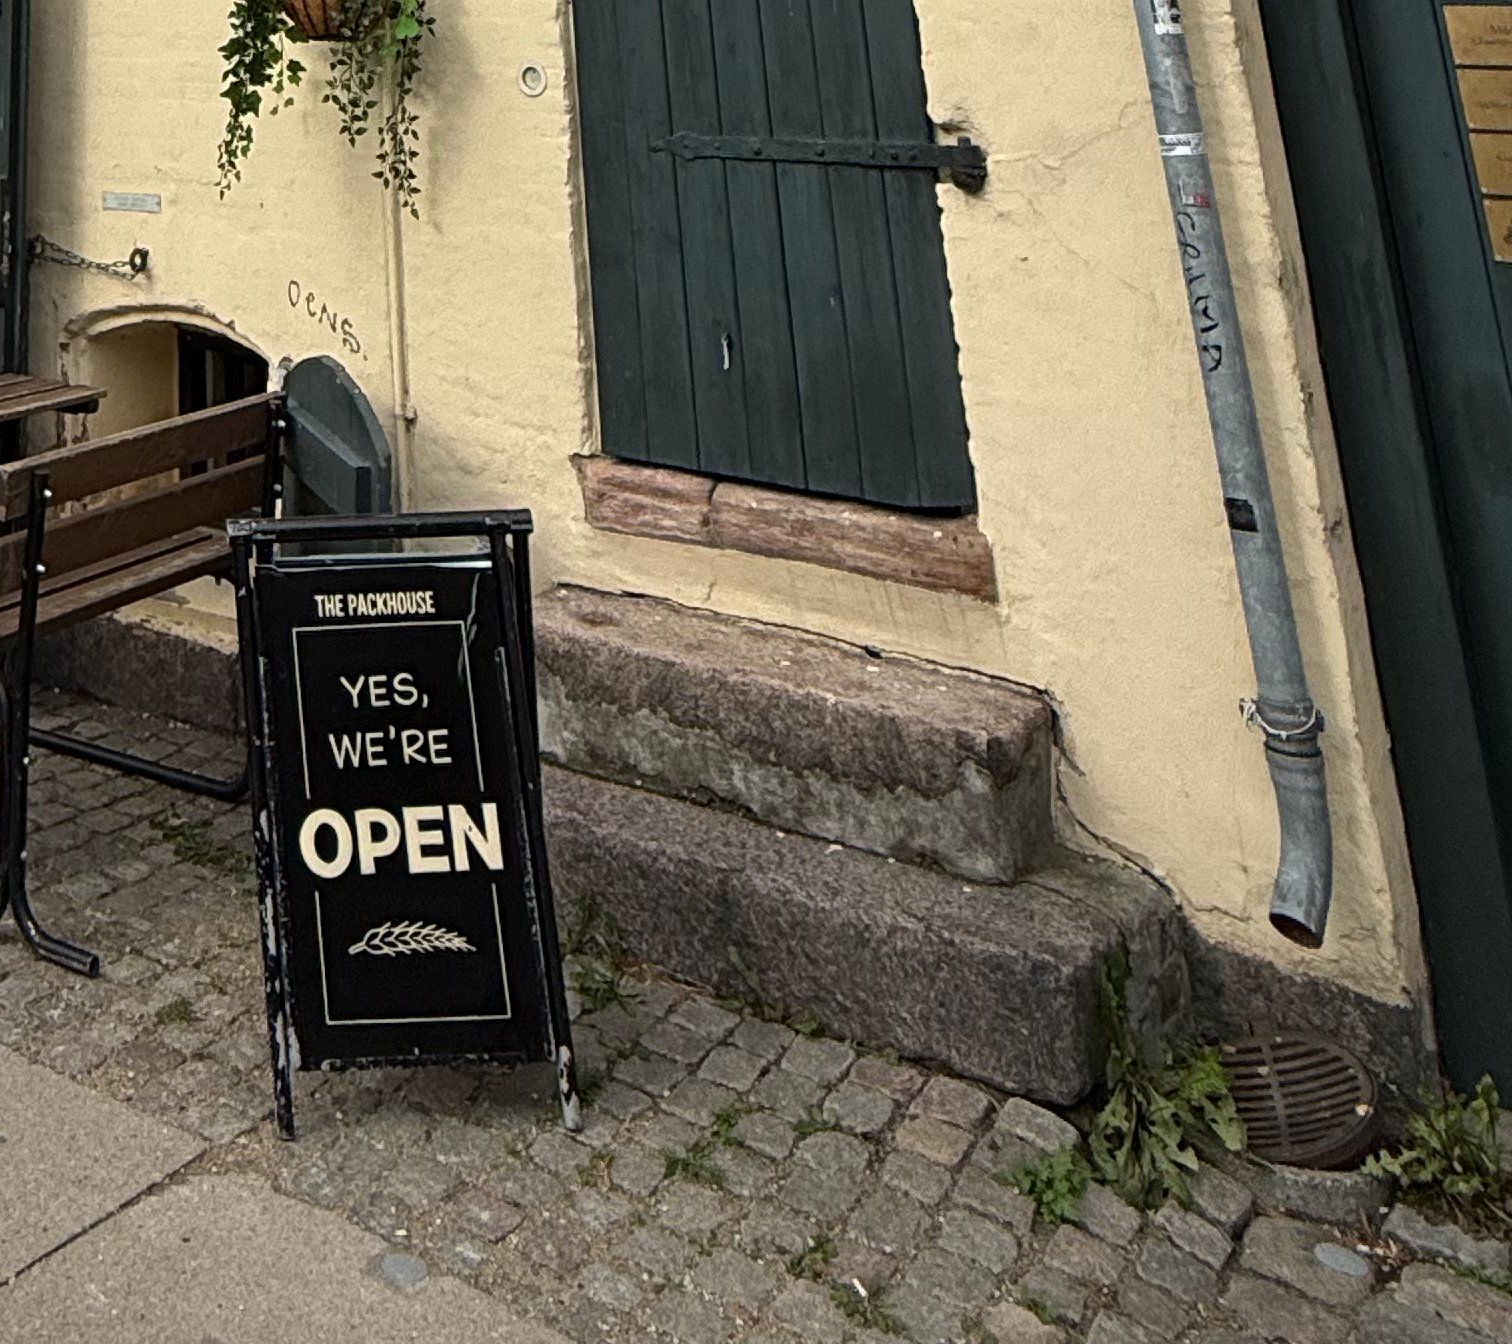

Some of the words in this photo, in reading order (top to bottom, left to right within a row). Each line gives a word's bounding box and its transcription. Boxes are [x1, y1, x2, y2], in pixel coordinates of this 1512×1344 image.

[314, 594, 345, 618] THE
[346, 591, 436, 616] PACKHOUSE
[339, 673, 429, 709] YES,
[328, 725, 452, 769] WE'RE
[298, 802, 505, 880] OPEN
